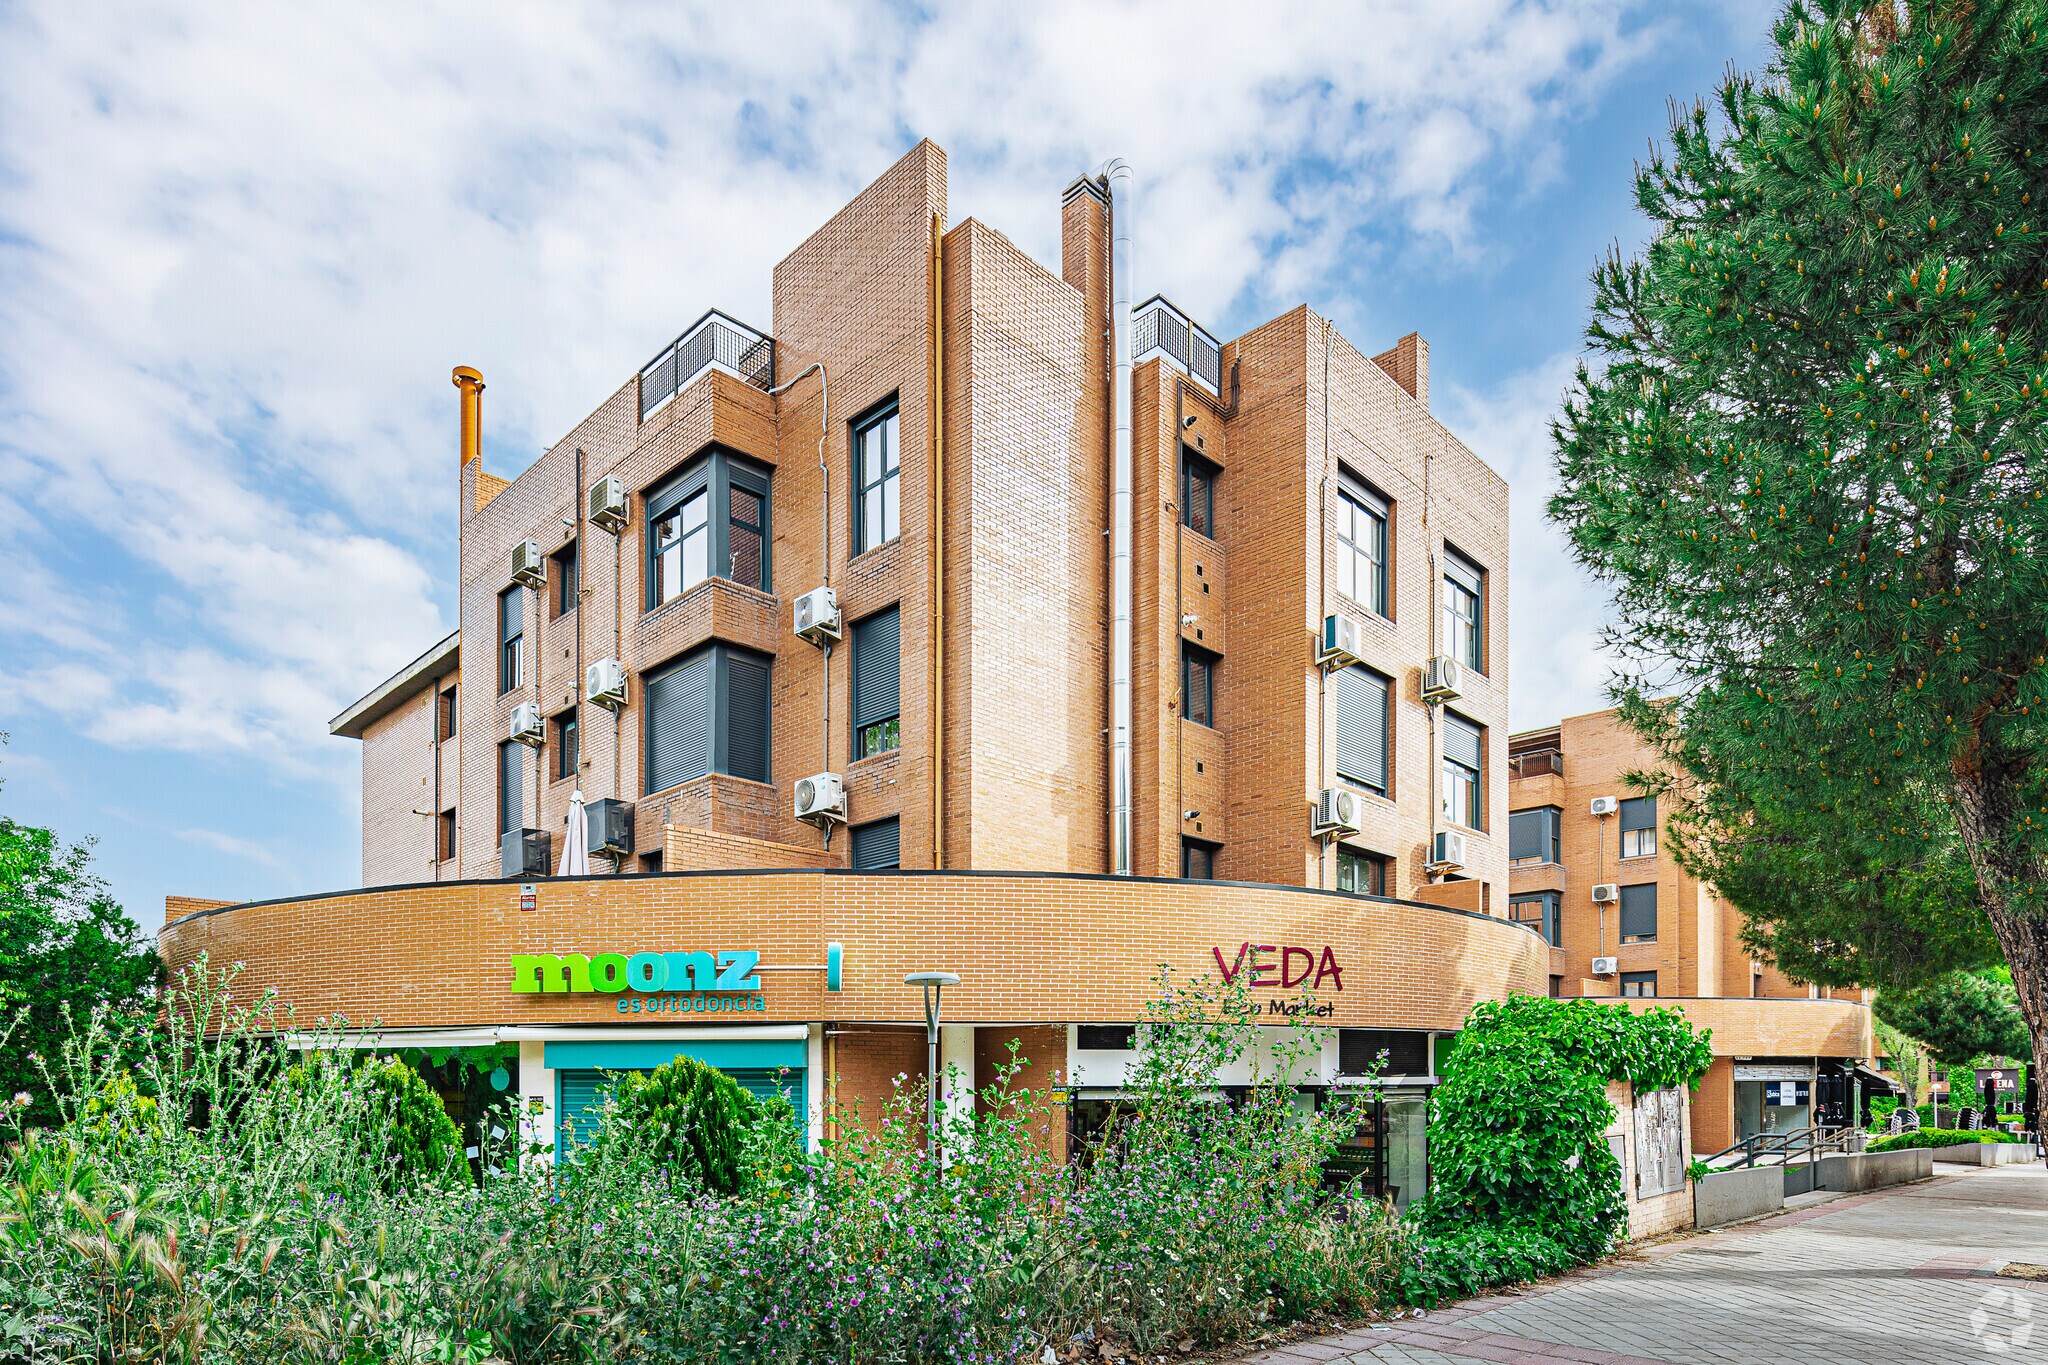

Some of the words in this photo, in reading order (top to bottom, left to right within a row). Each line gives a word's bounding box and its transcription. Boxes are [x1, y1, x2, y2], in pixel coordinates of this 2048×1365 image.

[511, 950, 761, 993] moonz
[1213, 942, 1343, 991] VEDA
[617, 997, 641, 1014] es
[646, 993, 766, 1012] ortodoncia
